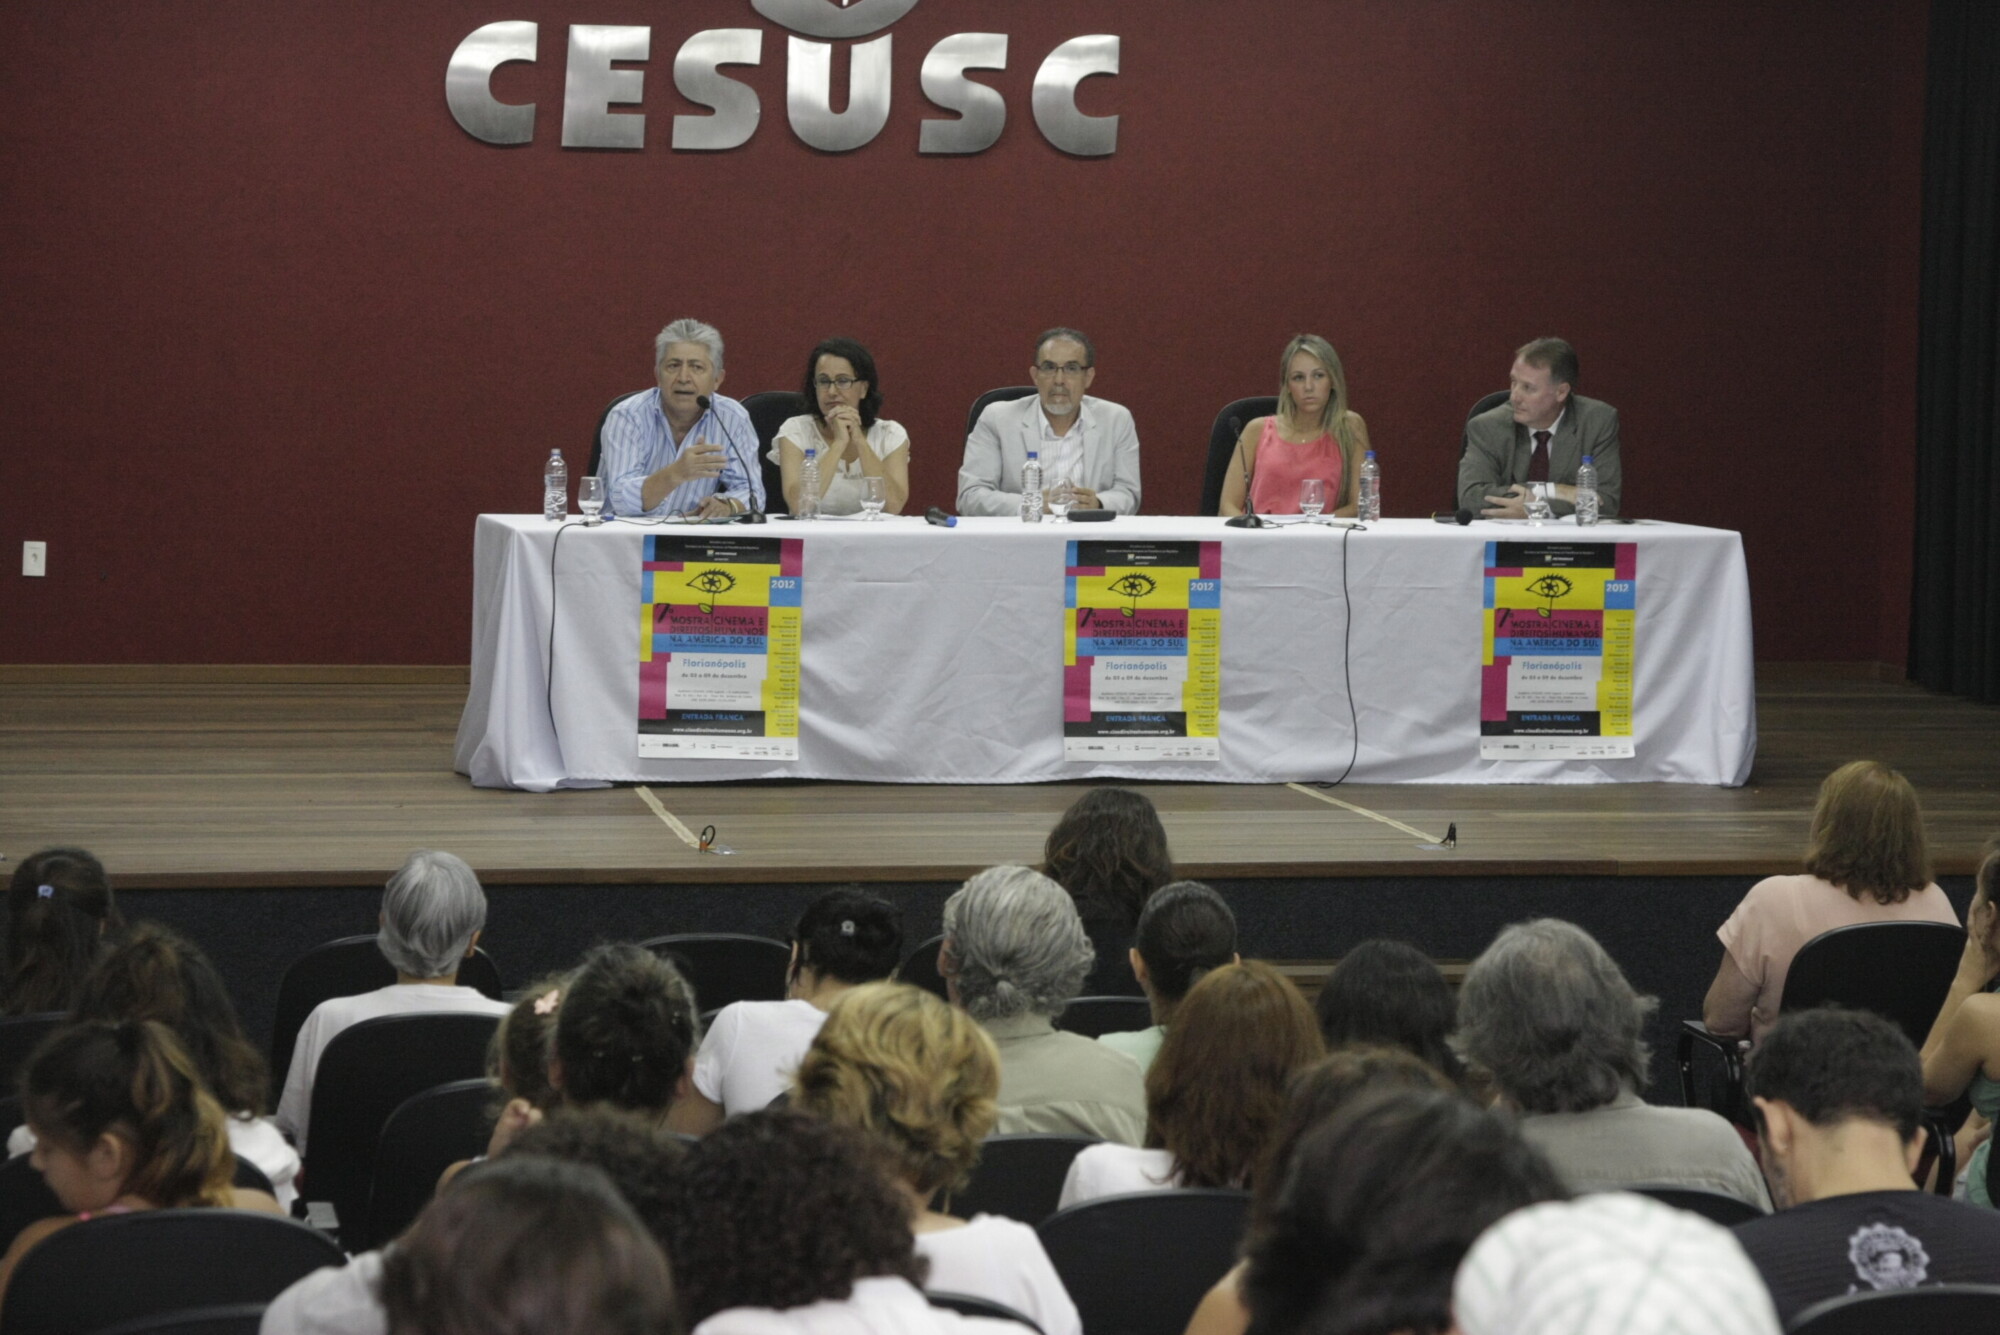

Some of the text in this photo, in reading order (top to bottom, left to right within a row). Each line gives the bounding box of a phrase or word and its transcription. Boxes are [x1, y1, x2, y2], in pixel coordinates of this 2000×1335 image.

[445, 20, 1120, 155] CESUSC
[771, 580, 795, 589] 2012
[1190, 582, 1214, 591] 2012
[1606, 584, 1629, 592] 2012
[670, 616, 709, 624] MOSTRA
[714, 616, 754, 625] CINEMA
[747, 637, 764, 645] SUL
[682, 658, 746, 668] Florianópolis
[1106, 662, 1167, 672] Florianópolis
[1522, 661, 1582, 671] Florianópolis
